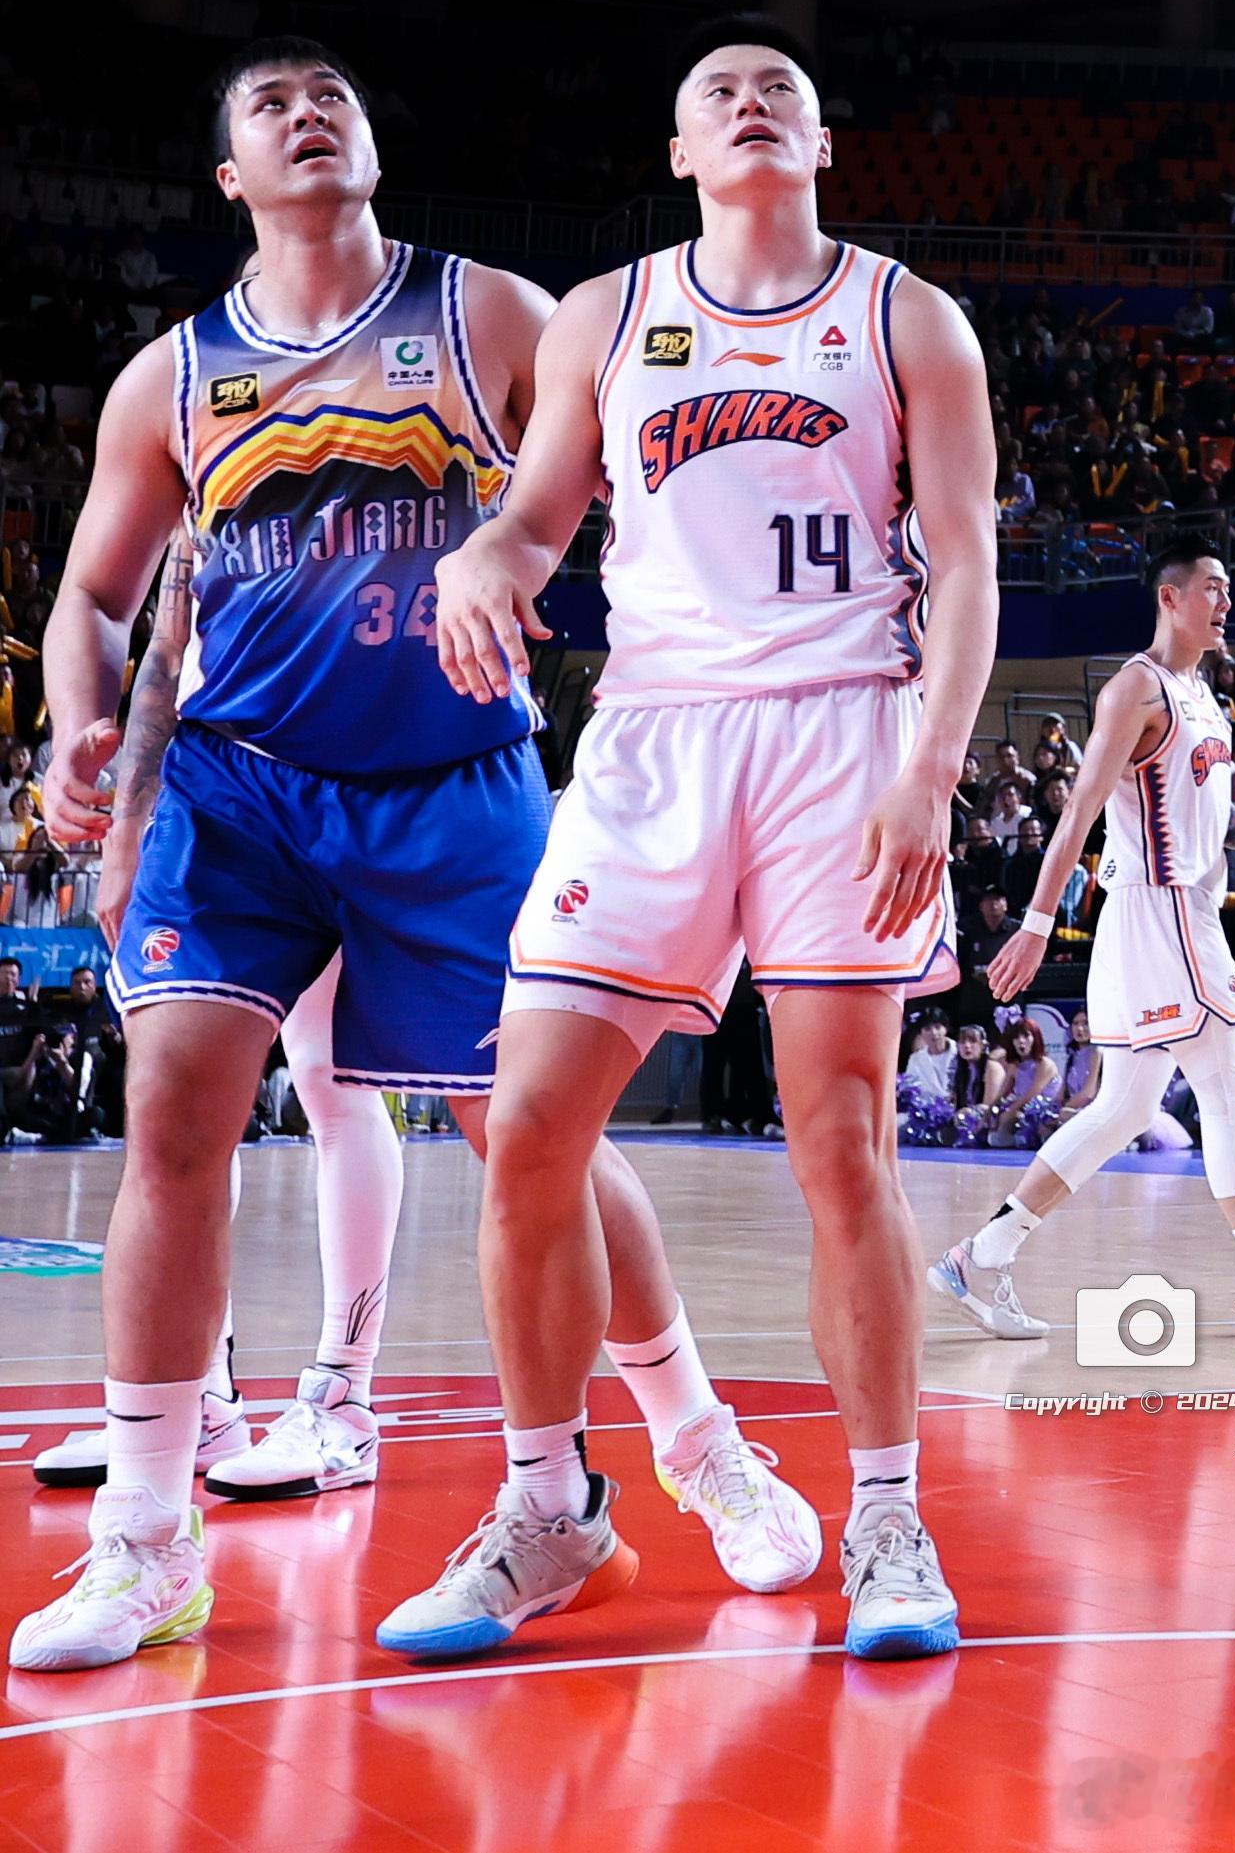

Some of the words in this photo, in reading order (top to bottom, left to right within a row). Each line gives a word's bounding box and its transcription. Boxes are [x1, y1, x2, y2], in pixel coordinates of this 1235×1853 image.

[820, 362, 843, 371] CGB
[639, 389, 849, 494] SHARKS
[221, 520, 294, 576] XIN
[310, 493, 446, 562] JIANG
[768, 514, 852, 592] 14
[353, 582, 438, 647] 34
